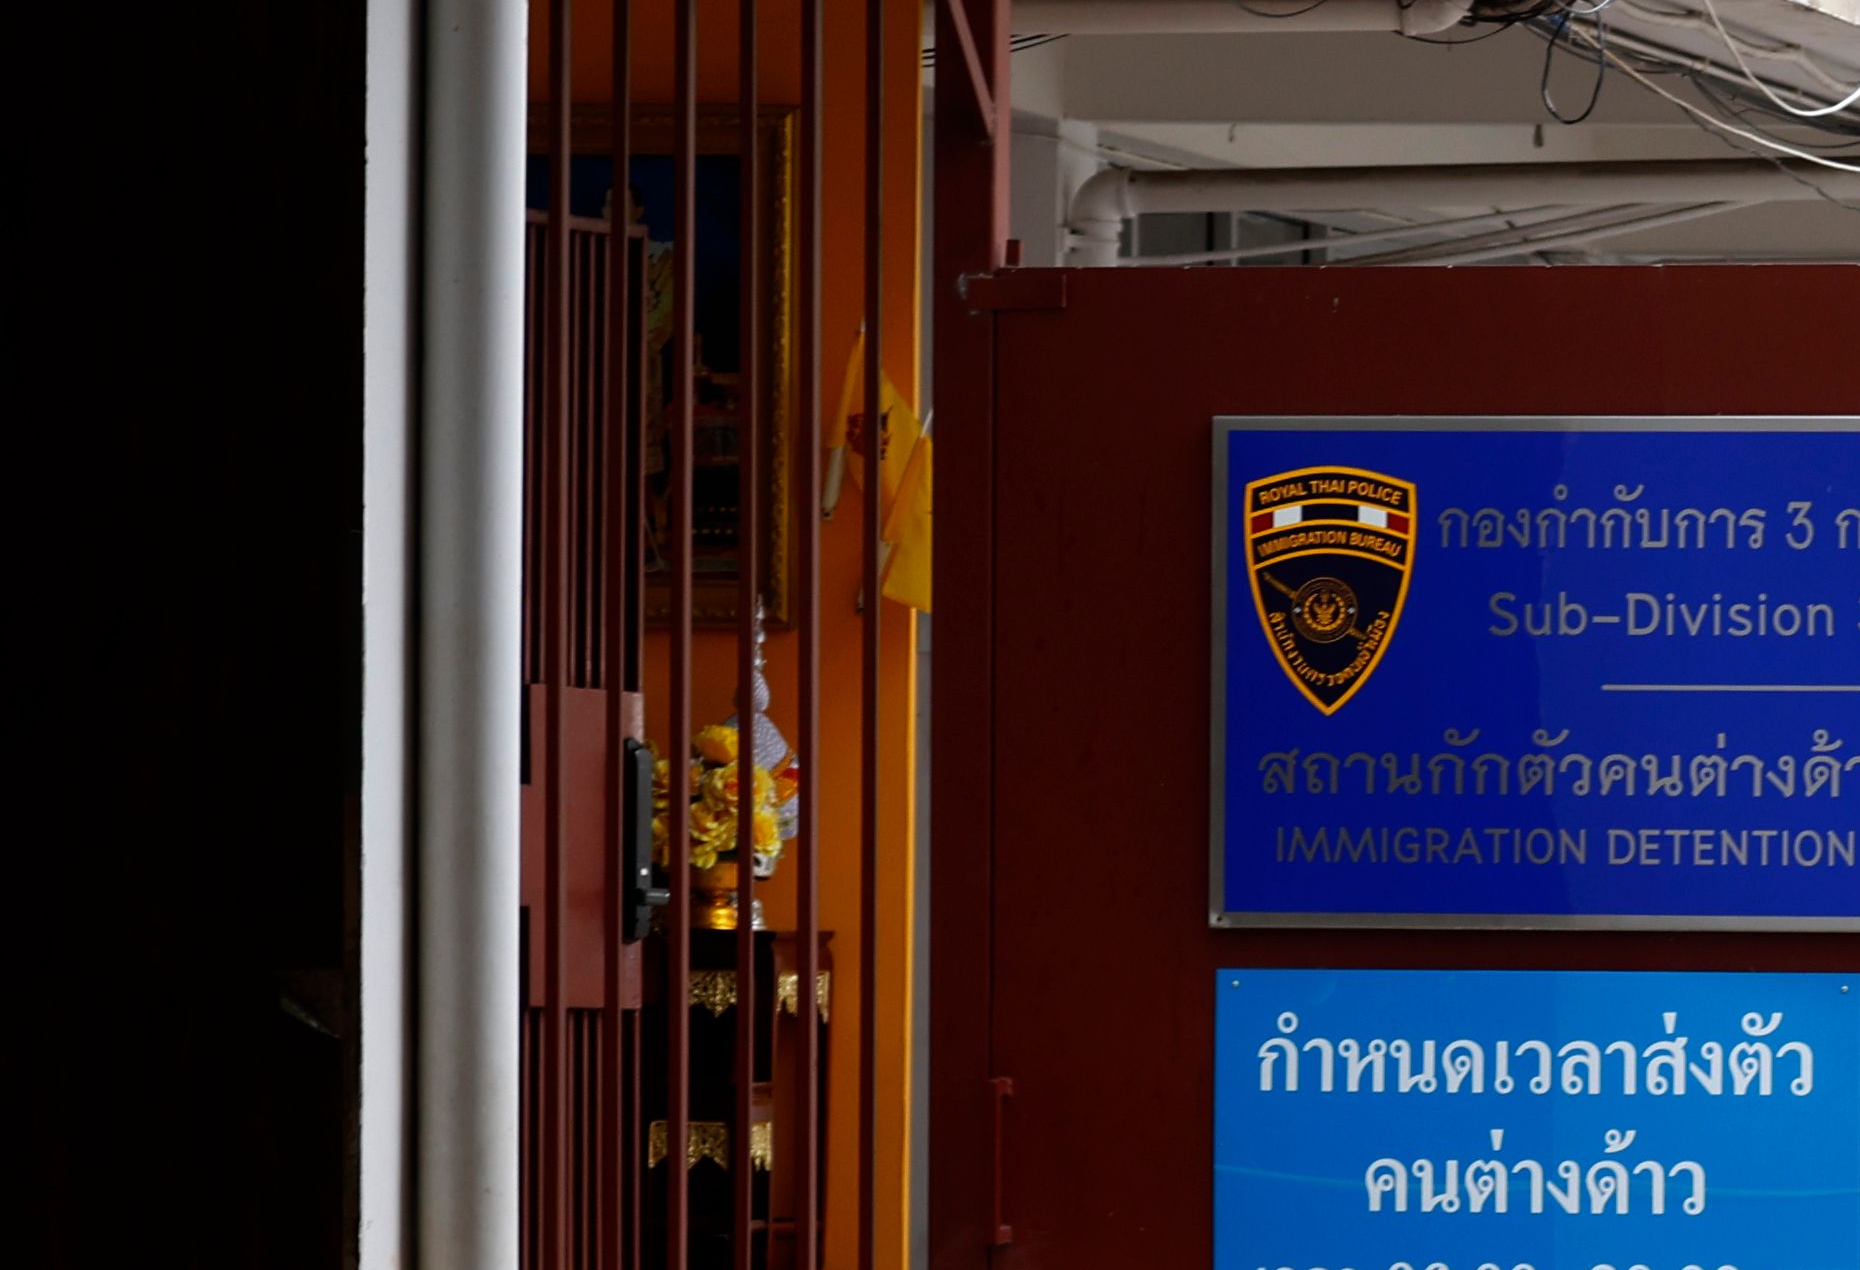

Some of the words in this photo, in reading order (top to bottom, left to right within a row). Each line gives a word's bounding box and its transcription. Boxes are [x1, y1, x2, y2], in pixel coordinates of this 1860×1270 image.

[1259, 482, 1308, 505] ROYAL
[1310, 479, 1345, 495] THAI
[1347, 480, 1403, 506] POLICE
[1440, 484, 1766, 550] กองกำกับการ
[1785, 501, 1814, 550] 3
[1257, 531, 1347, 558] IMMIGRATION
[1349, 531, 1402, 557] BUREAU
[1488, 591, 1834, 637] Sub-Division
[1275, 826, 1586, 865] IMMIGRATION
[1607, 828, 1855, 867] DETENTION
[1258, 1011, 1814, 1096] กำหนดเวลาส่งตัว
[1365, 1128, 1706, 1216] คนต่างด้าว
